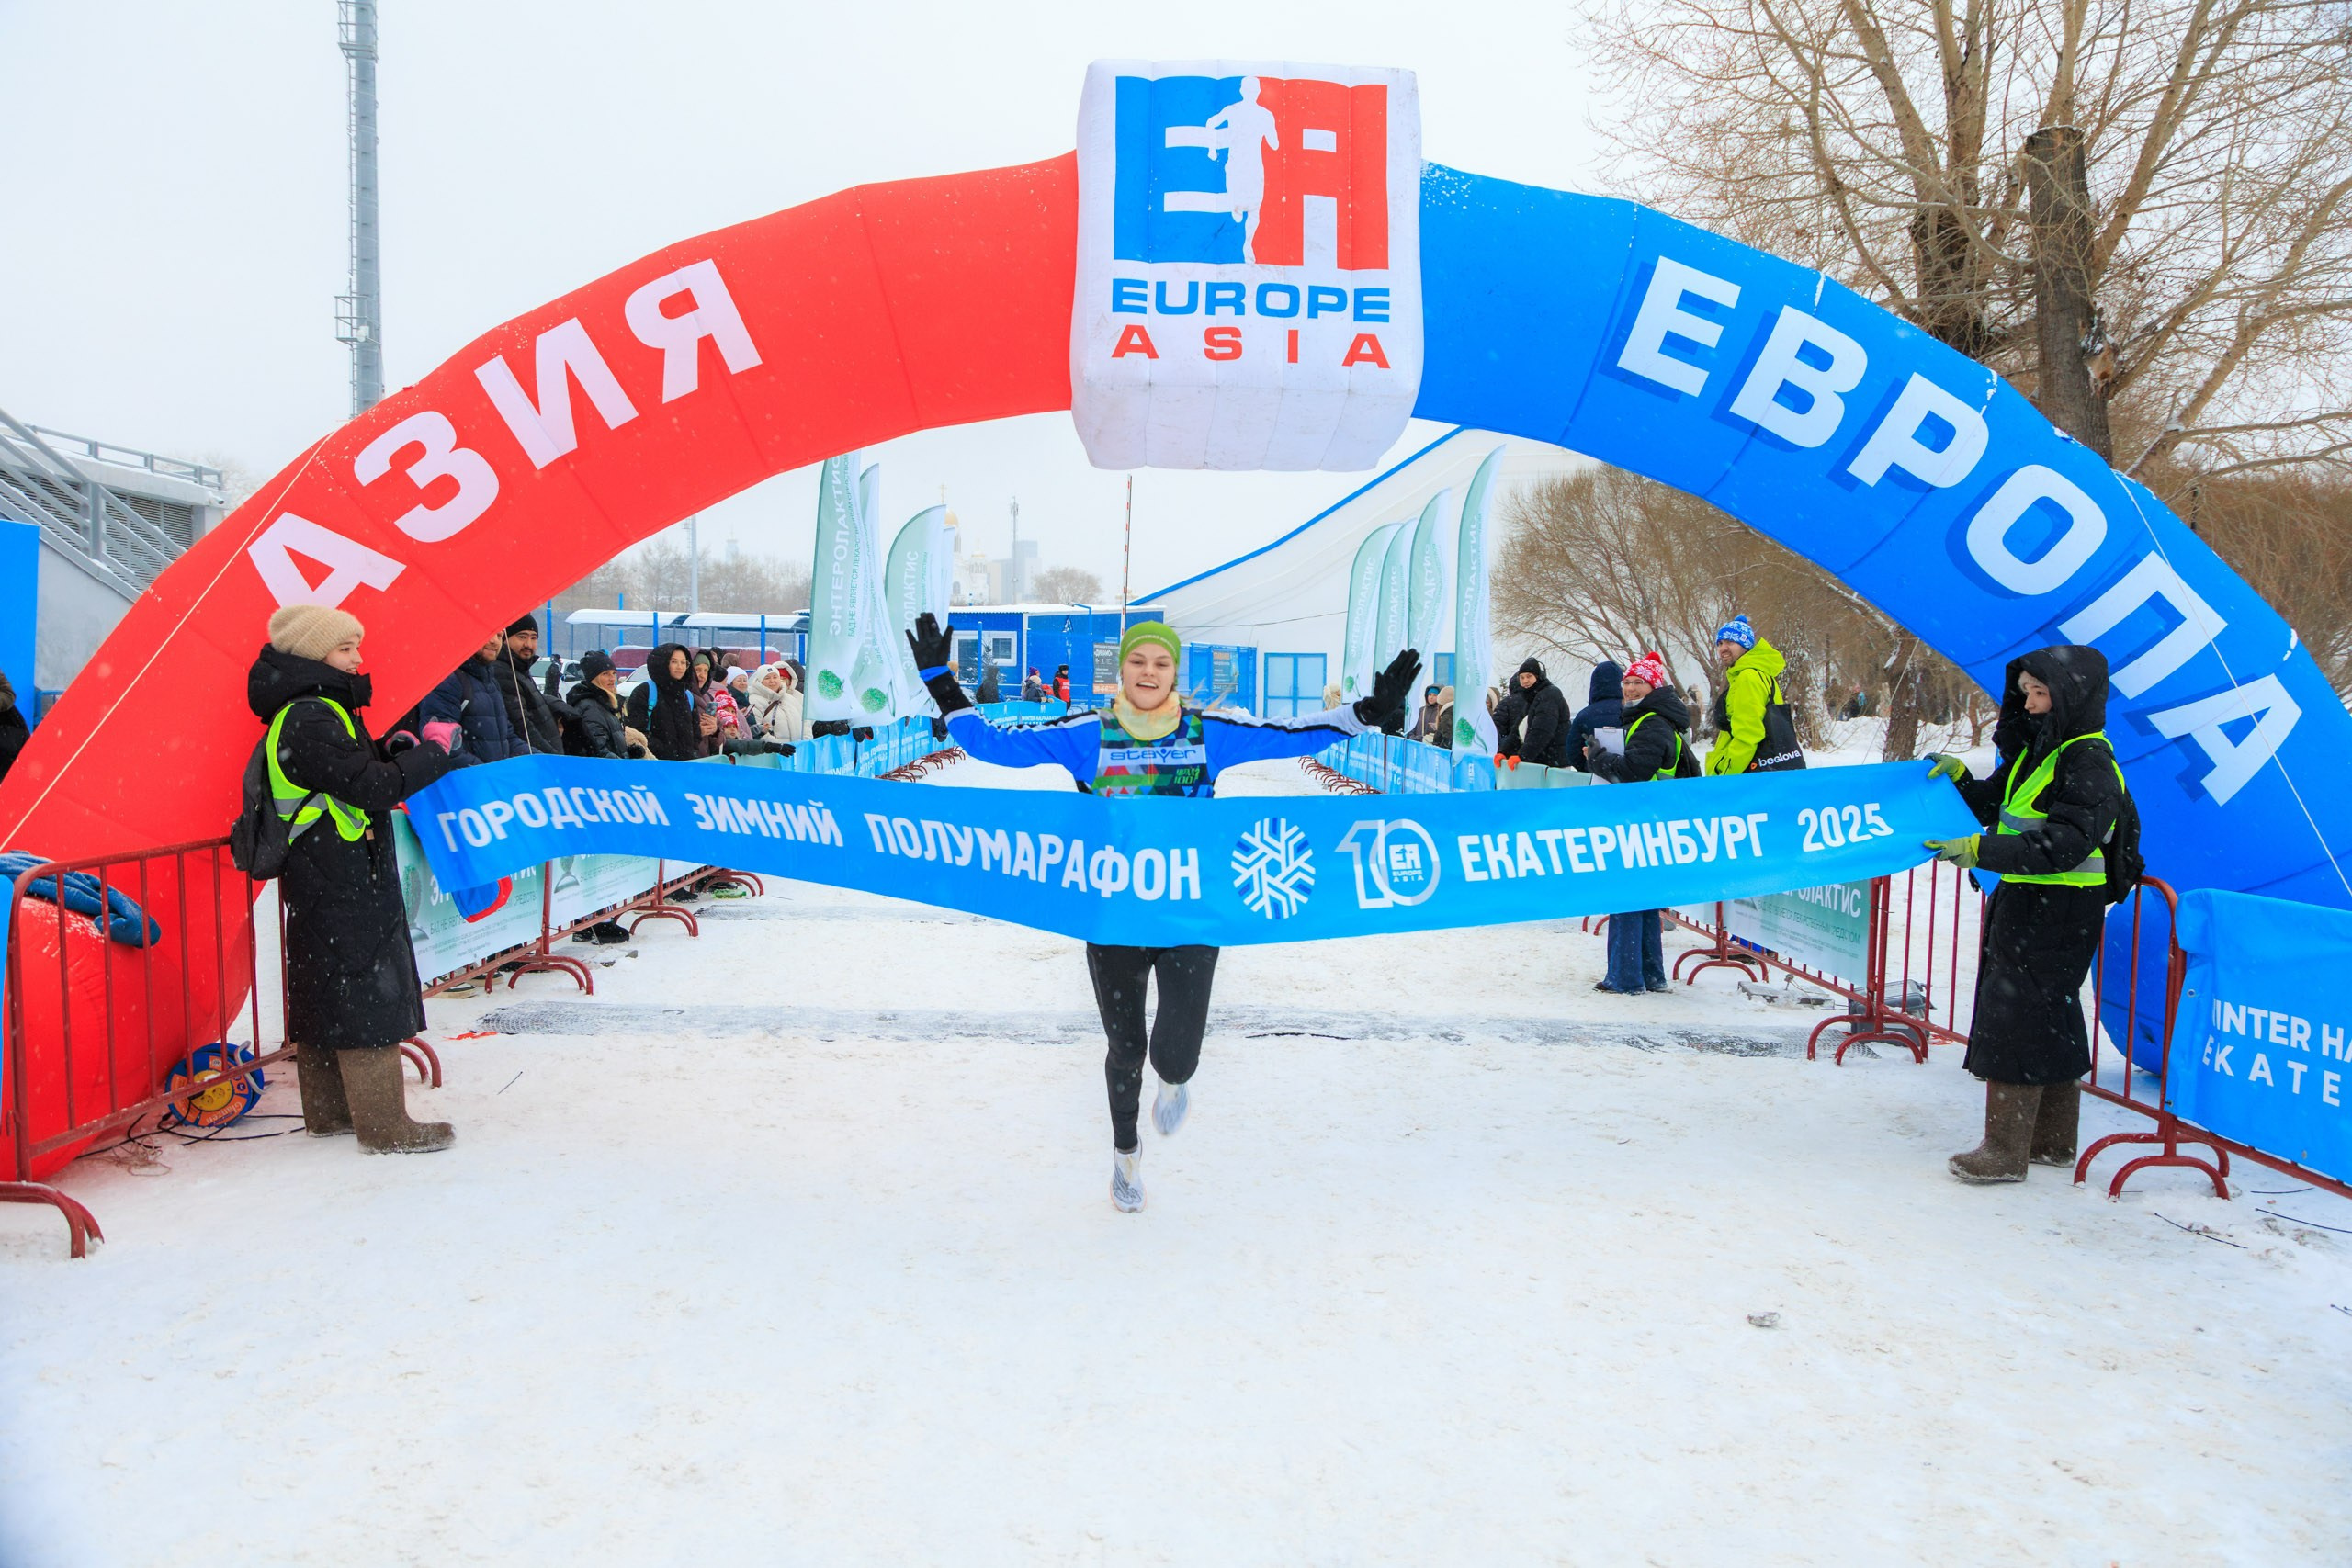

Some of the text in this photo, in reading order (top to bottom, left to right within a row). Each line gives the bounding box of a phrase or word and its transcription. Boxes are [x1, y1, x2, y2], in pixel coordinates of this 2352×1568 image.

[1112, 278, 1390, 323] EUROPE
[1111, 324, 1392, 369] ASIA
[247, 258, 763, 610] АЗИЯ
[1616, 255, 2302, 807] ЕВРОПА
[1110, 748, 1196, 763] stayer
[437, 784, 1201, 901] ГОРОДСКОЙ ЗИМНИЙ ПОЛУМАРАФОН
[1457, 802, 1894, 882] ЕКАТЕРИНБУРГ 2025
[1392, 869, 1423, 877] EUROPE
[1393, 874, 1424, 883] ASIA
[2212, 998, 2310, 1052] INTER
[206, 1101, 243, 1124] Glanzen
